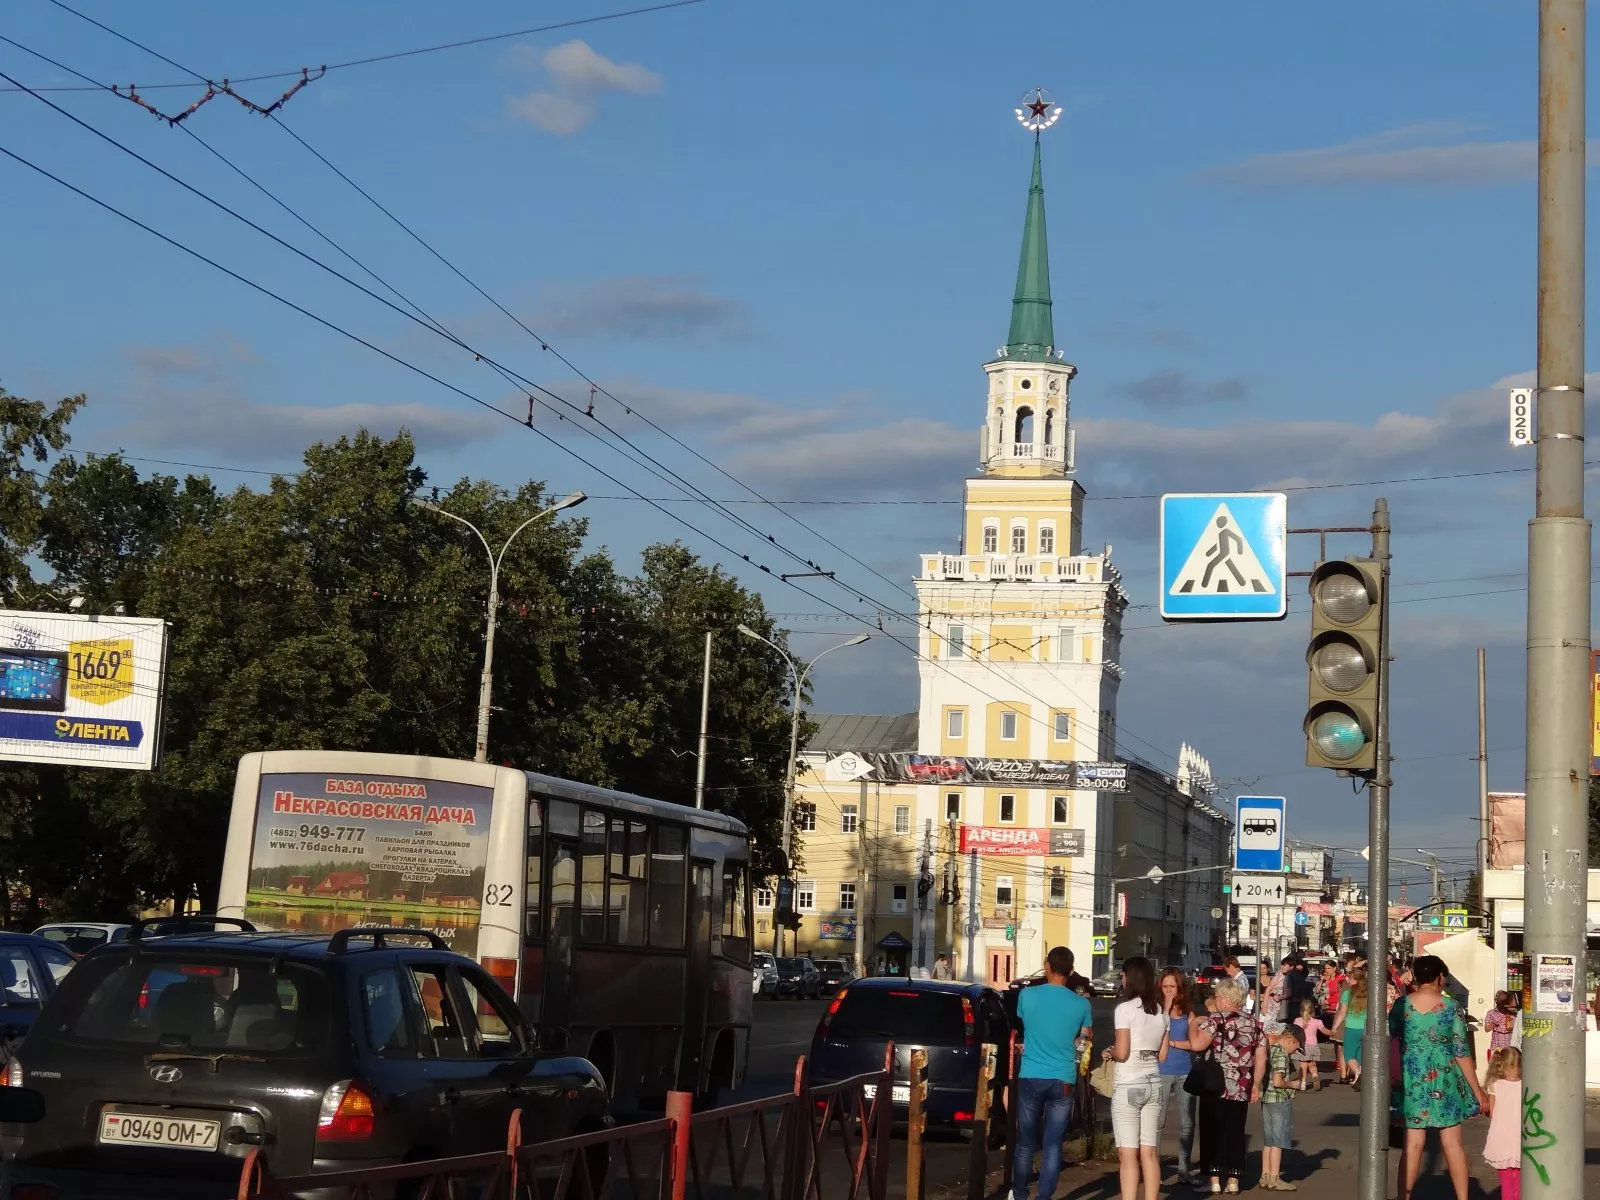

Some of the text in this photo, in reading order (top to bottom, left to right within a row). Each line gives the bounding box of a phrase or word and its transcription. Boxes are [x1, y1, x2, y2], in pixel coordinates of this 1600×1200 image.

[1515, 394, 1526, 439] 0026
[73, 651, 120, 680] 1669
[69, 723, 130, 741] ЛЕНТА
[994, 772, 1070, 781] ЗАВЕДИ ИДЕАЛ
[1076, 778, 1126, 788] 58-00-40
[326, 779, 427, 798] БАЗА ОТДЫХА
[425, 806, 476, 825] ДАЧА
[270, 824, 366, 842] (4852) 949-777
[376, 836, 410, 844] ПАВИЛЬОН
[426, 840, 470, 848] ПРАЗДНИКОВ
[968, 829, 1040, 844] АРЕНДА
[270, 841, 364, 854] www.76dacha.ru
[382, 855, 416, 863] ПРОГУЛКИ
[486, 884, 514, 906] 82
[1247, 884, 1262, 896] 20
[106, 1118, 216, 1145] BY 0949 OM-7
